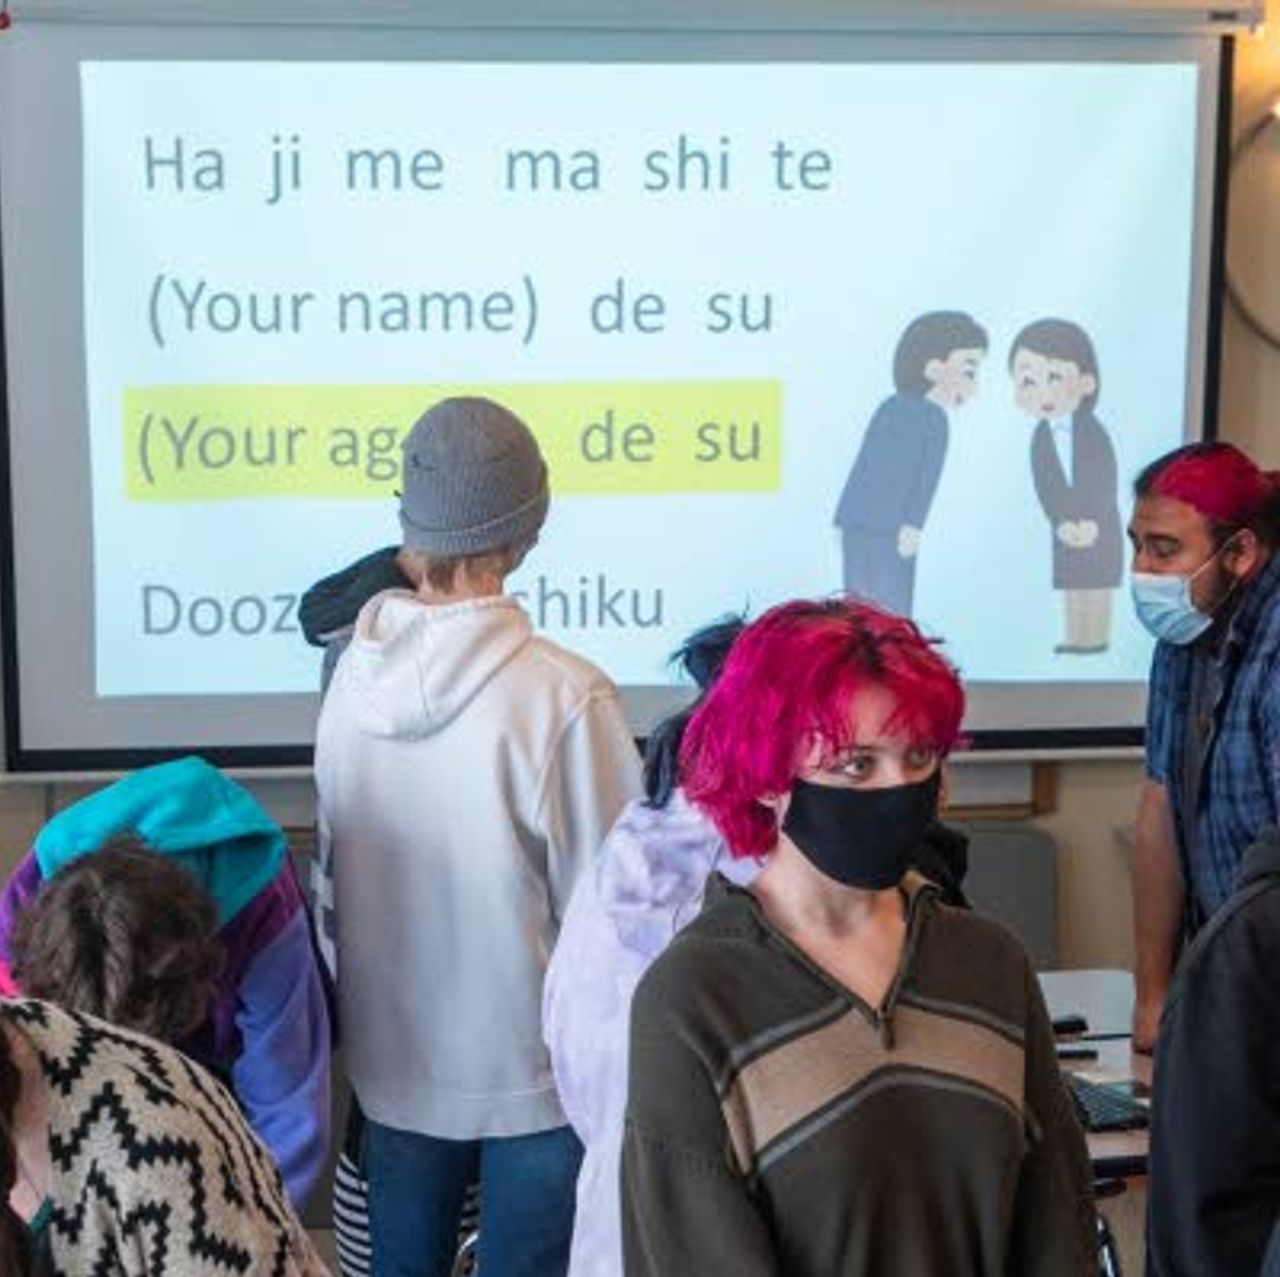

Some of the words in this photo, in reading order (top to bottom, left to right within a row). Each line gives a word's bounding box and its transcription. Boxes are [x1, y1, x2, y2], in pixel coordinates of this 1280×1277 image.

[145, 136, 224, 191] Ha
[265, 134, 300, 205] ji
[347, 149, 444, 191] me
[506, 149, 600, 191] ma
[644, 134, 729, 191] shi
[771, 141, 832, 191] te
[150, 274, 315, 348] (Your
[339, 274, 537, 346] name)
[591, 277, 665, 334] de
[707, 294, 772, 332] su
[140, 413, 308, 484] (Your
[329, 426, 398, 481] ag
[581, 410, 655, 462] de
[695, 422, 760, 462] su
[143, 584, 298, 636] Dooz
[511, 574, 663, 628] hiku
